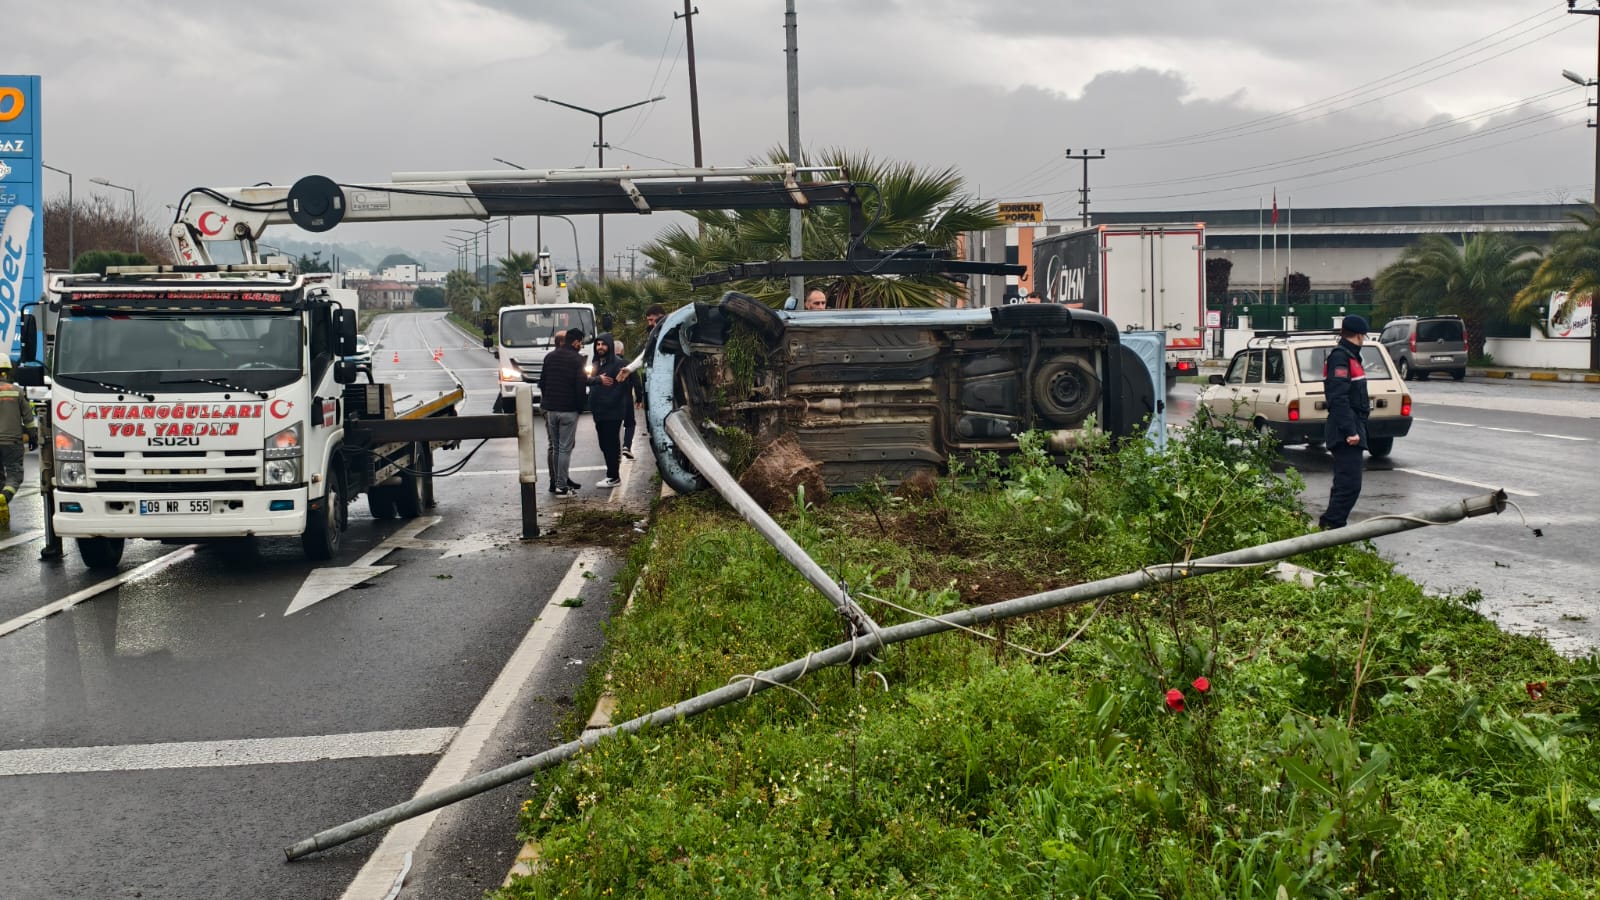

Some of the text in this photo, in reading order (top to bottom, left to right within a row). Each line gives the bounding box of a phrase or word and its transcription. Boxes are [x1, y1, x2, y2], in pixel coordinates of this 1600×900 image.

[1005, 213, 1036, 222] POMPA
[83, 403, 263, 419] AYHANOĞULLARI
[108, 422, 239, 437] YOL YARDIM
[147, 437, 200, 446] ISUZU
[147, 500, 209, 512] 09 NR 555
